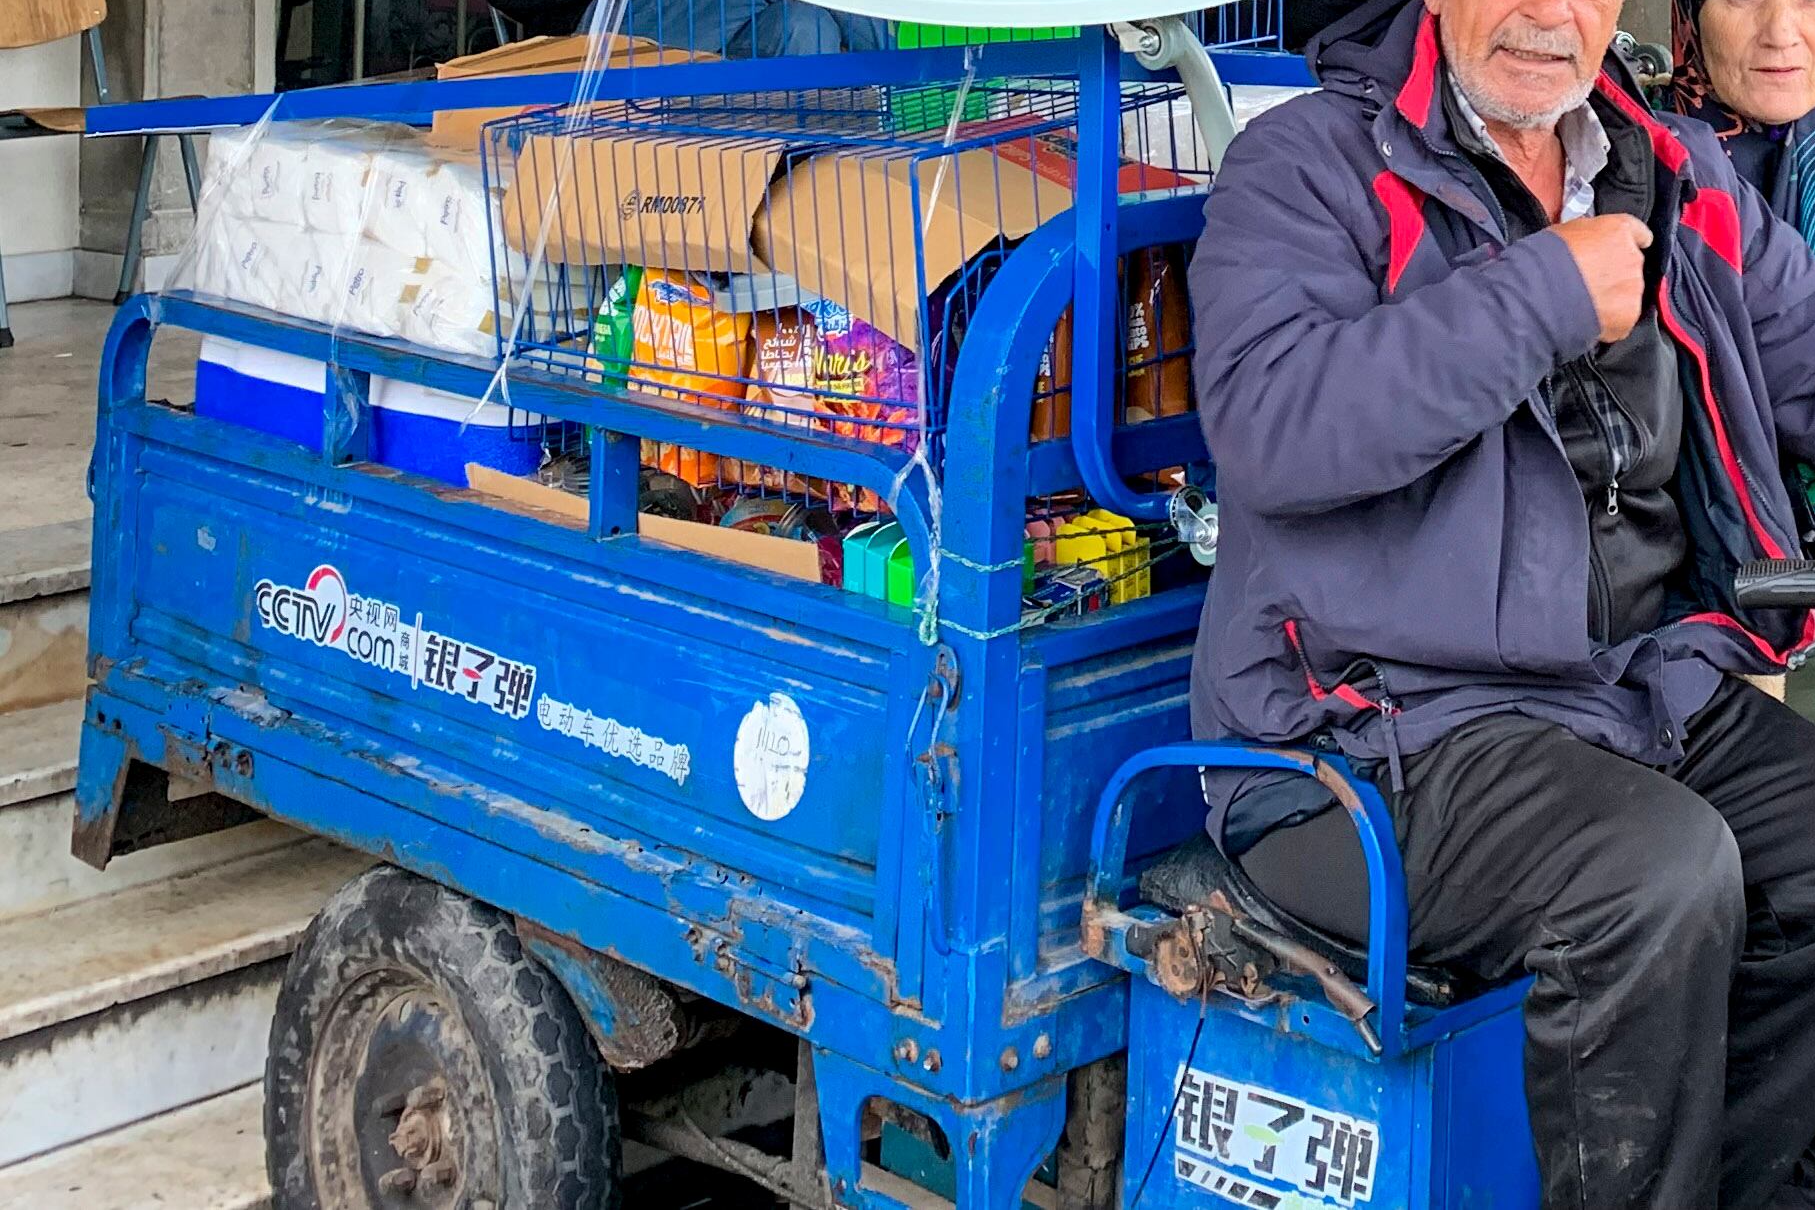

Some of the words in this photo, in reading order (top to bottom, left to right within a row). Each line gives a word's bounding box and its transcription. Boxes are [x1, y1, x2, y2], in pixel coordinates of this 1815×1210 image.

[255, 582, 337, 643] CCTV
[349, 596, 399, 633] 央视网
